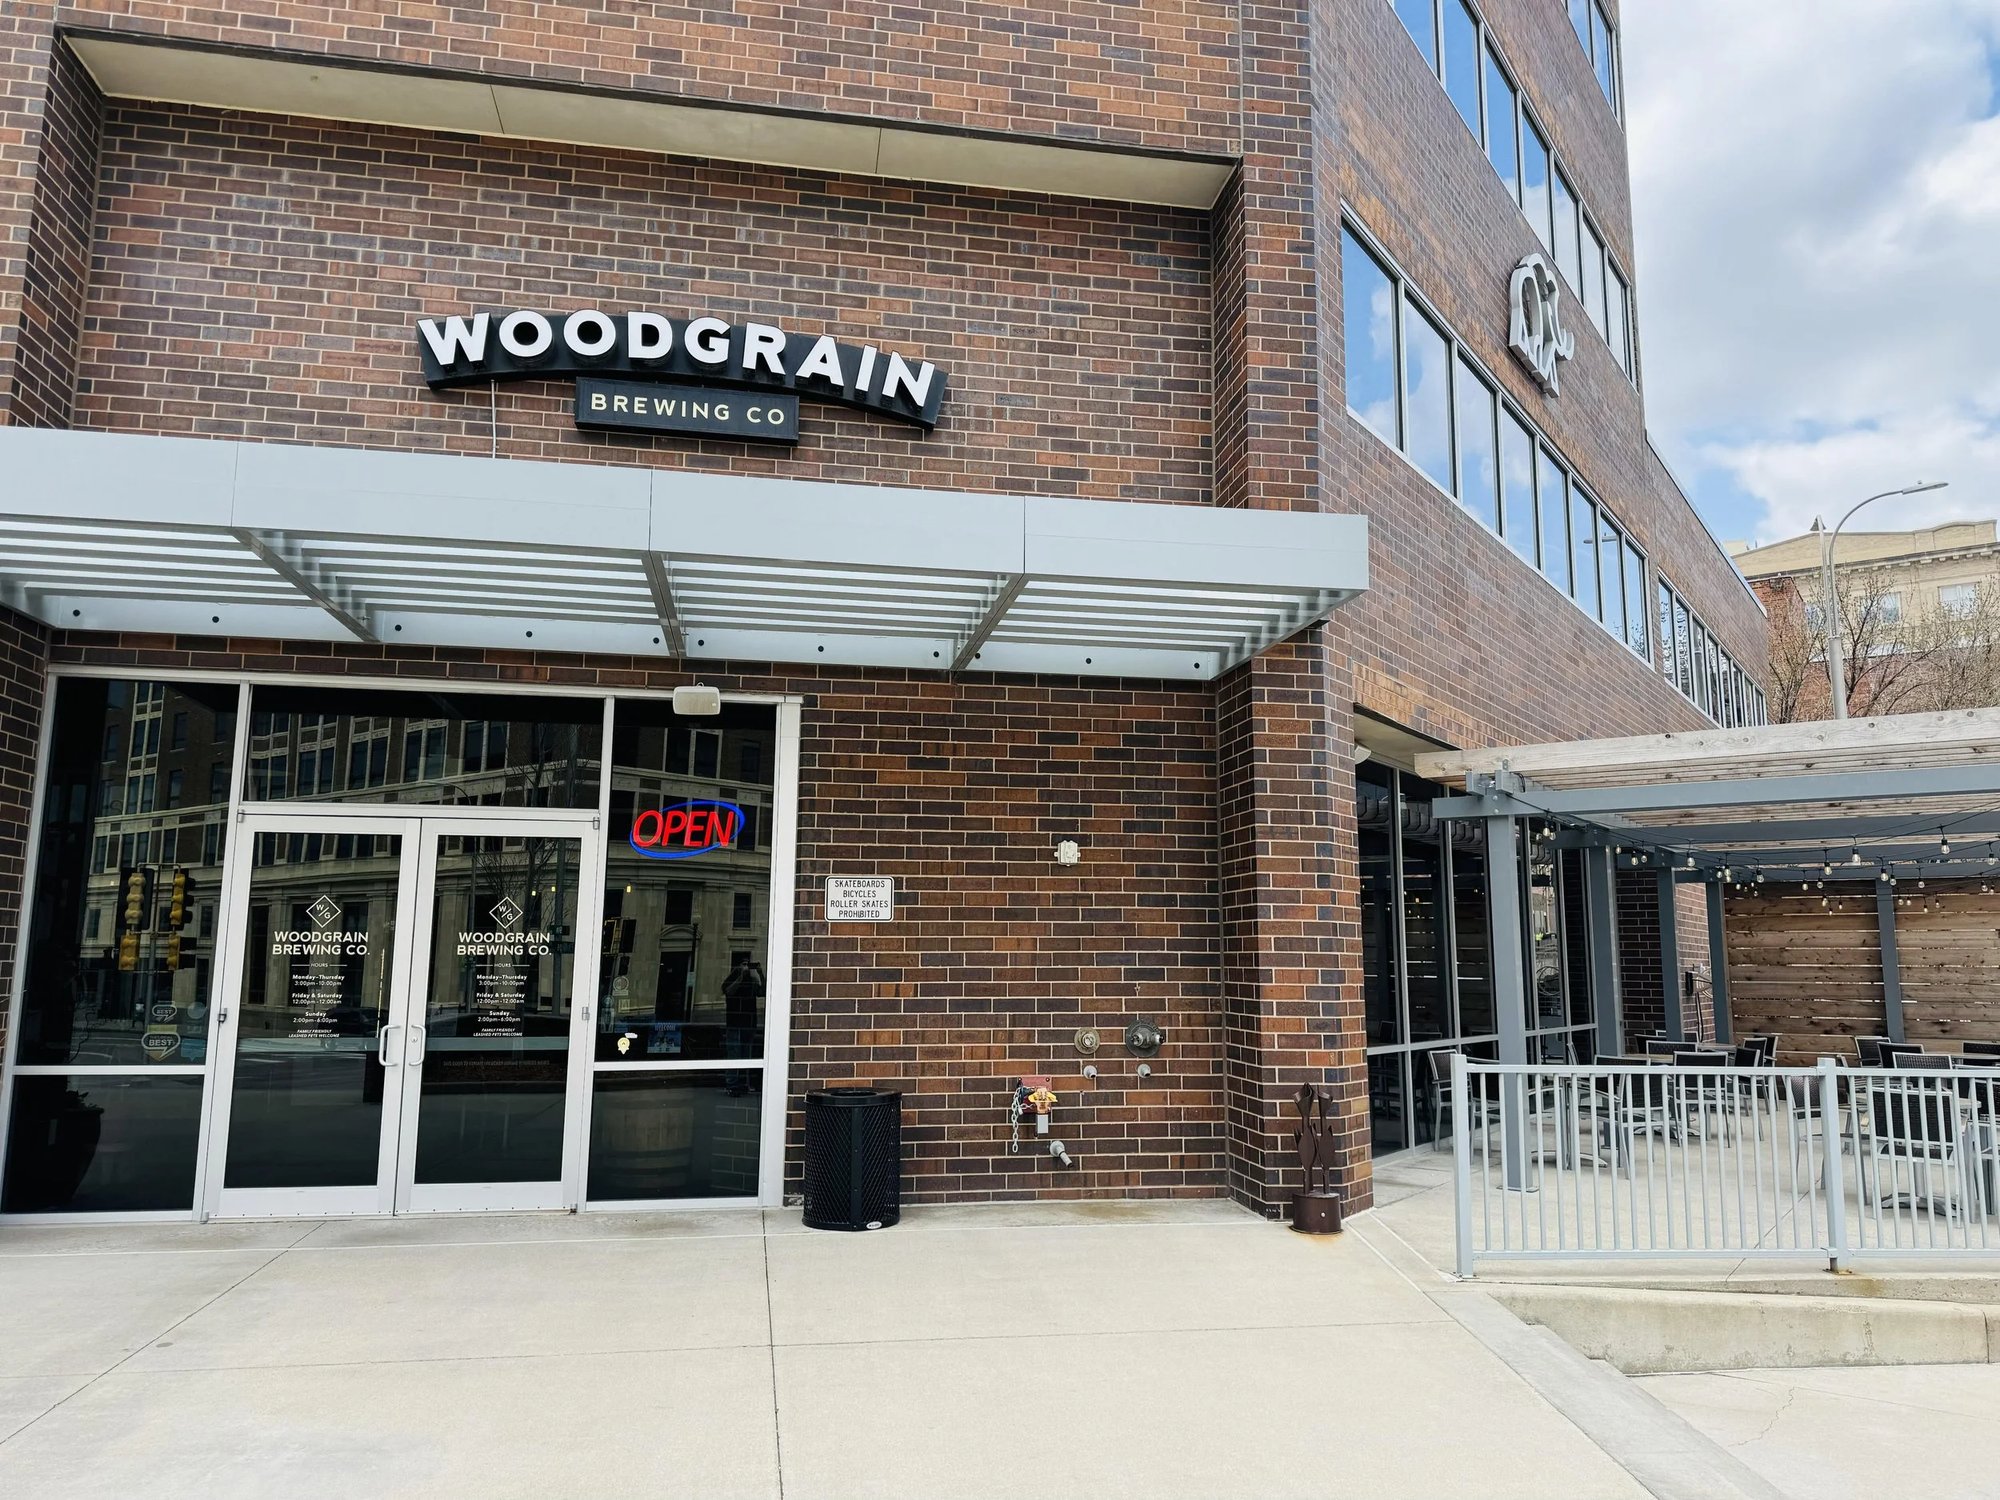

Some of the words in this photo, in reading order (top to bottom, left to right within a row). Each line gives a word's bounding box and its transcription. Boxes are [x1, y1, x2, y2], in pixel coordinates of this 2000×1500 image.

[416, 309, 936, 408] WOODGRAIN
[590, 393, 731, 422] BREWING
[746, 405, 786, 425] CO
[632, 810, 734, 847] OPEN
[834, 880, 885, 888] SKATEBOARDS
[843, 890, 876, 898] BICYCLES
[830, 900, 858, 908] ROLLER
[862, 900, 888, 908] SKATES
[838, 910, 880, 918] PROHIBITED
[274, 931, 369, 943] WOODGRAIN
[458, 932, 550, 943] WOODGRAIN
[272, 944, 341, 956] BREWING
[346, 944, 370, 956] CO.
[457, 945, 524, 956] BREWING
[528, 945, 552, 956] CO.
